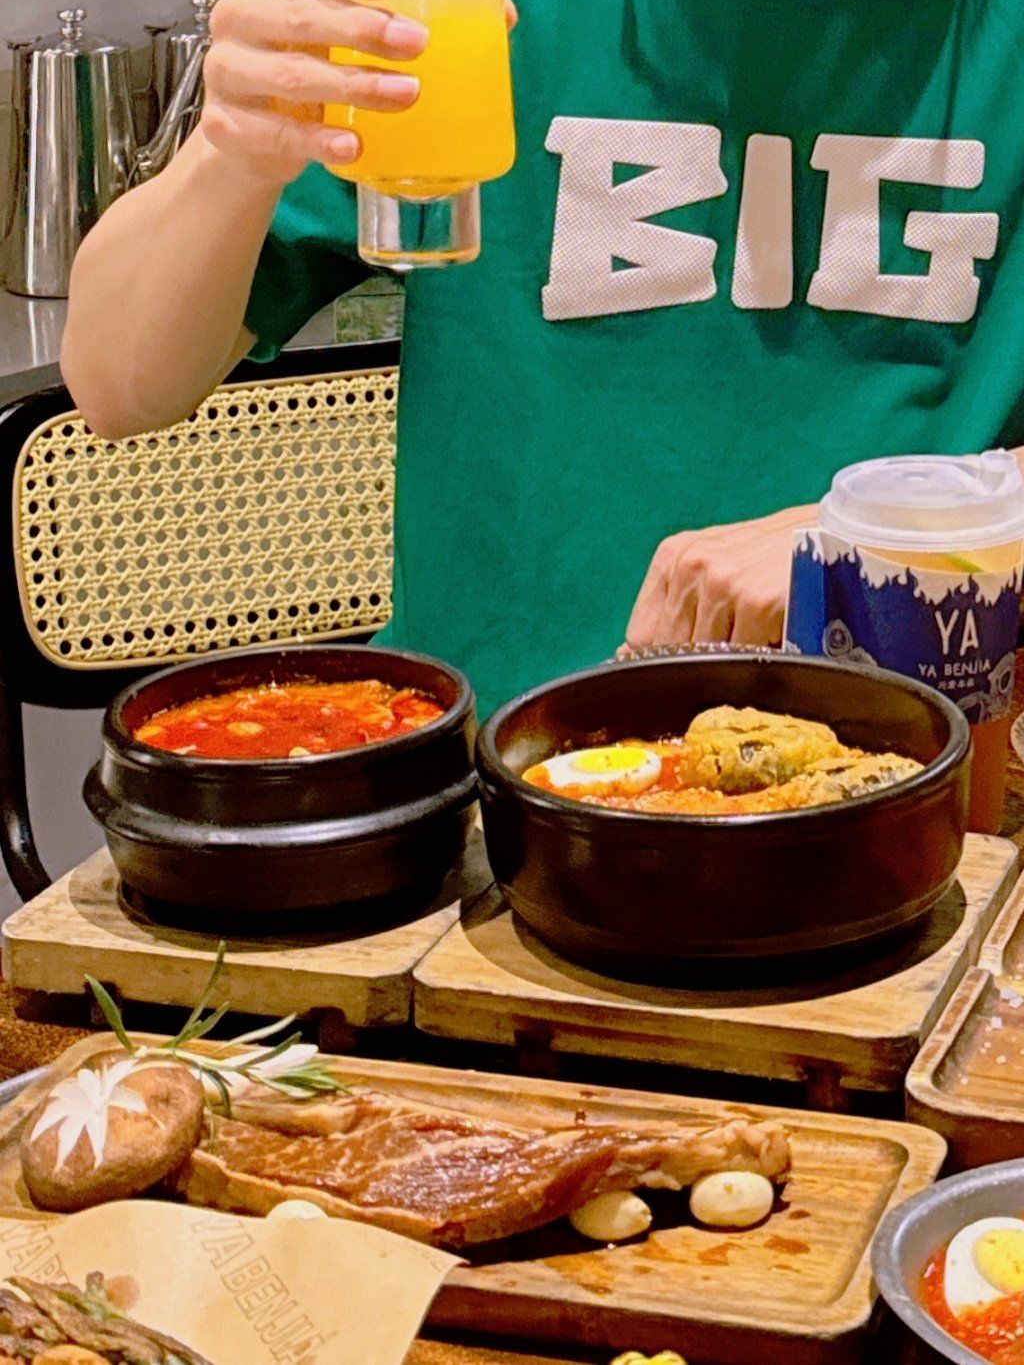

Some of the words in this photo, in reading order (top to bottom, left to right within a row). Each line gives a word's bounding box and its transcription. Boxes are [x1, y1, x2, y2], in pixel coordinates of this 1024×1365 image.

[541, 115, 1000, 324] BIG
[934, 608, 979, 657] YA
[918, 663, 938, 678] YA
[943, 658, 991, 676] BENJIA
